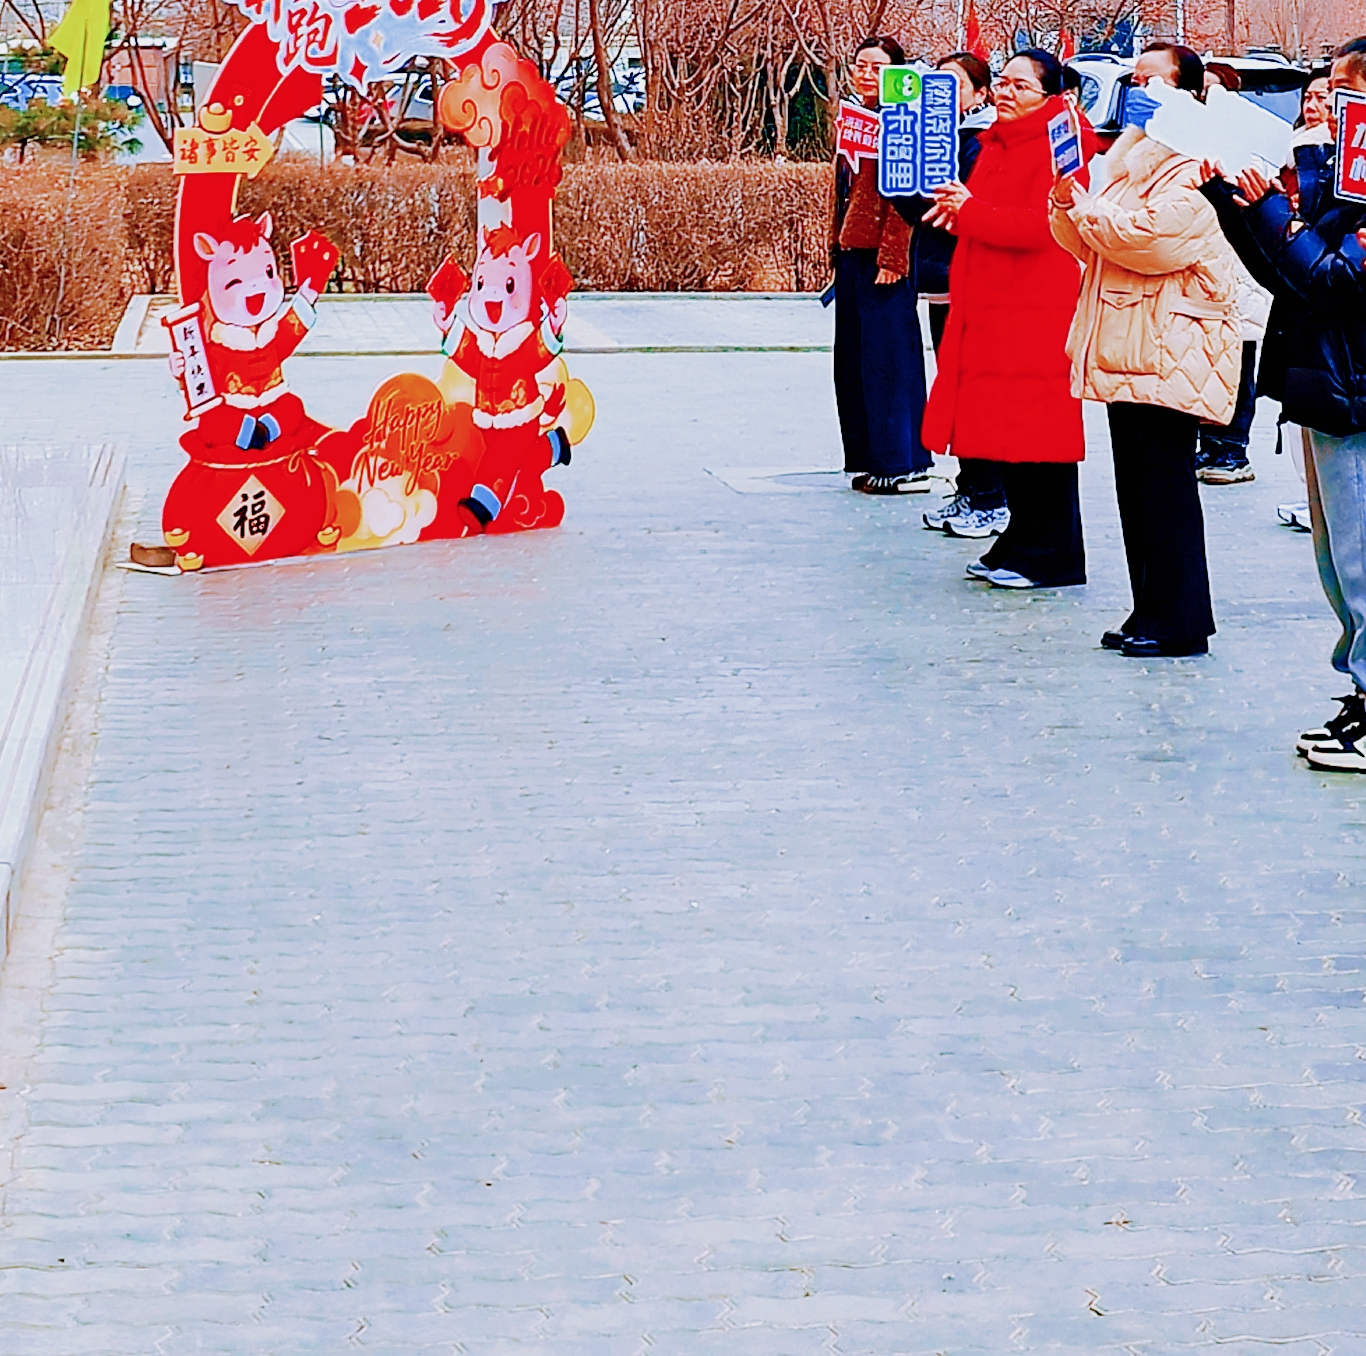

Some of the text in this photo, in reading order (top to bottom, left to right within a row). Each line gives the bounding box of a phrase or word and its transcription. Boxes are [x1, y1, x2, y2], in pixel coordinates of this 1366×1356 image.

[886, 105, 914, 189] 卡路里
[924, 77, 954, 190] 燃烧你的
[362, 397, 444, 454] Happy
[351, 442, 460, 497] New Year
[232, 490, 271, 539] 福
